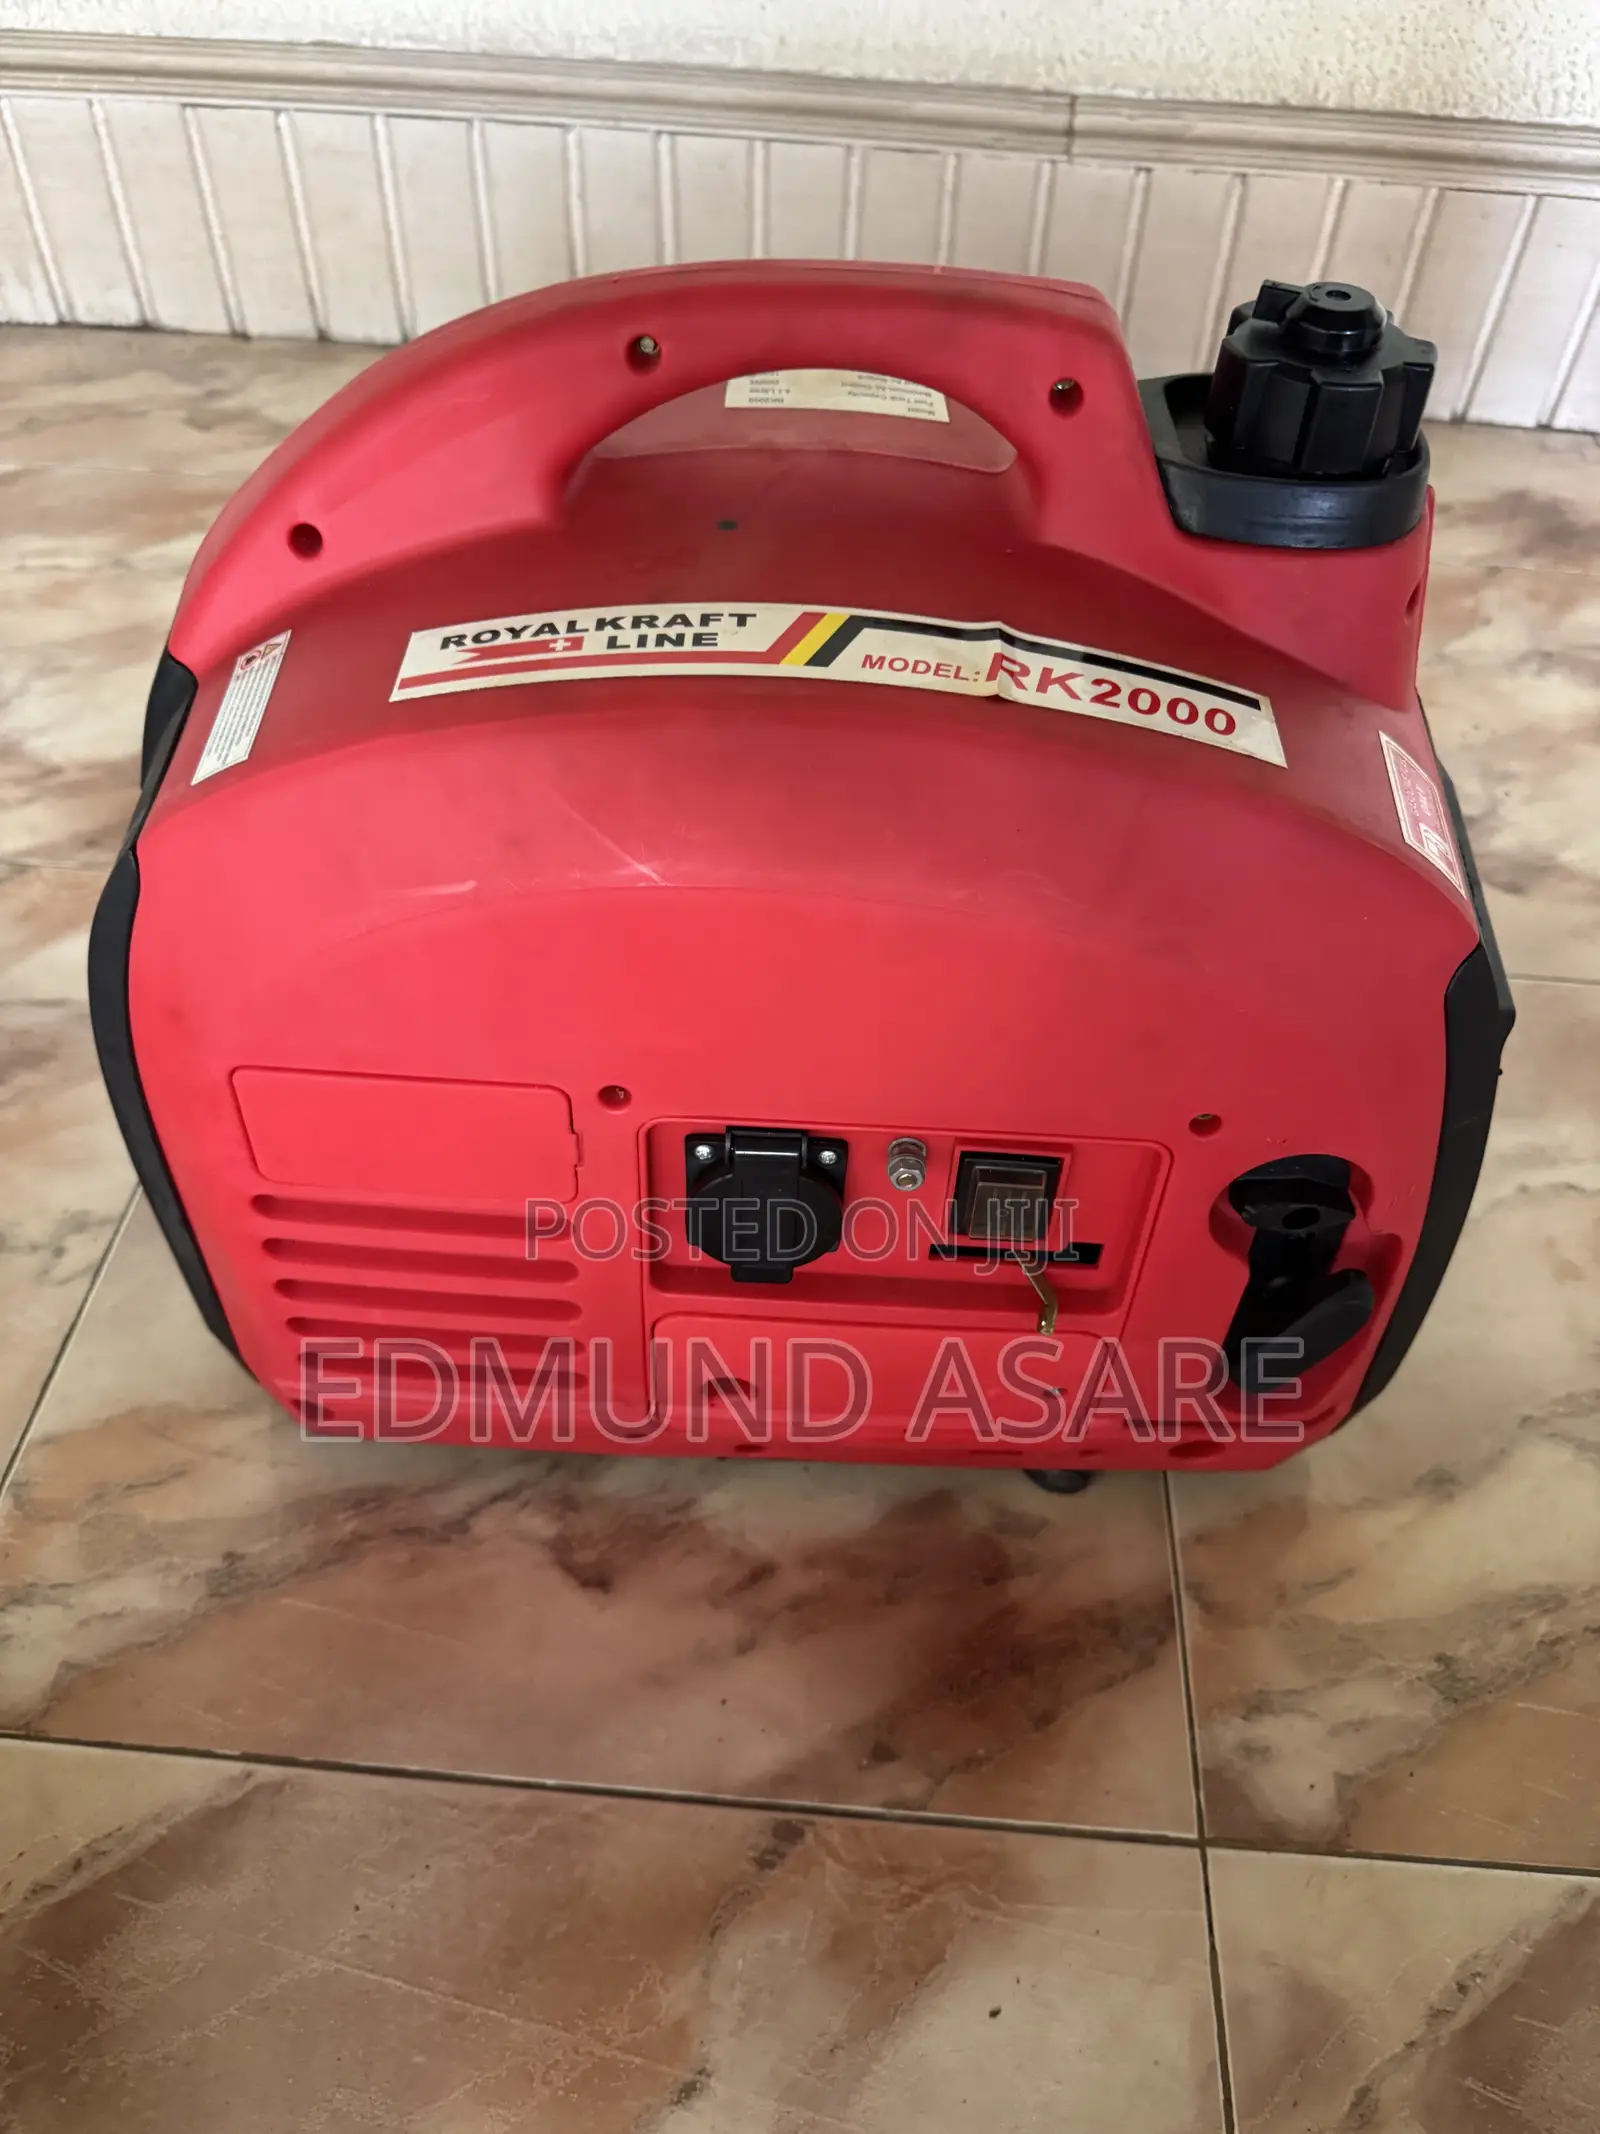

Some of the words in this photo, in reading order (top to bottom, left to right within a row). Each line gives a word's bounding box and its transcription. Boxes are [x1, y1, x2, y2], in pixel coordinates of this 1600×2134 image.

[439, 612, 758, 650] ROYALKRAFT
[606, 632, 719, 650] LINE
[861, 654, 981, 682] MODEL:
[984, 651, 1237, 737] RK2000
